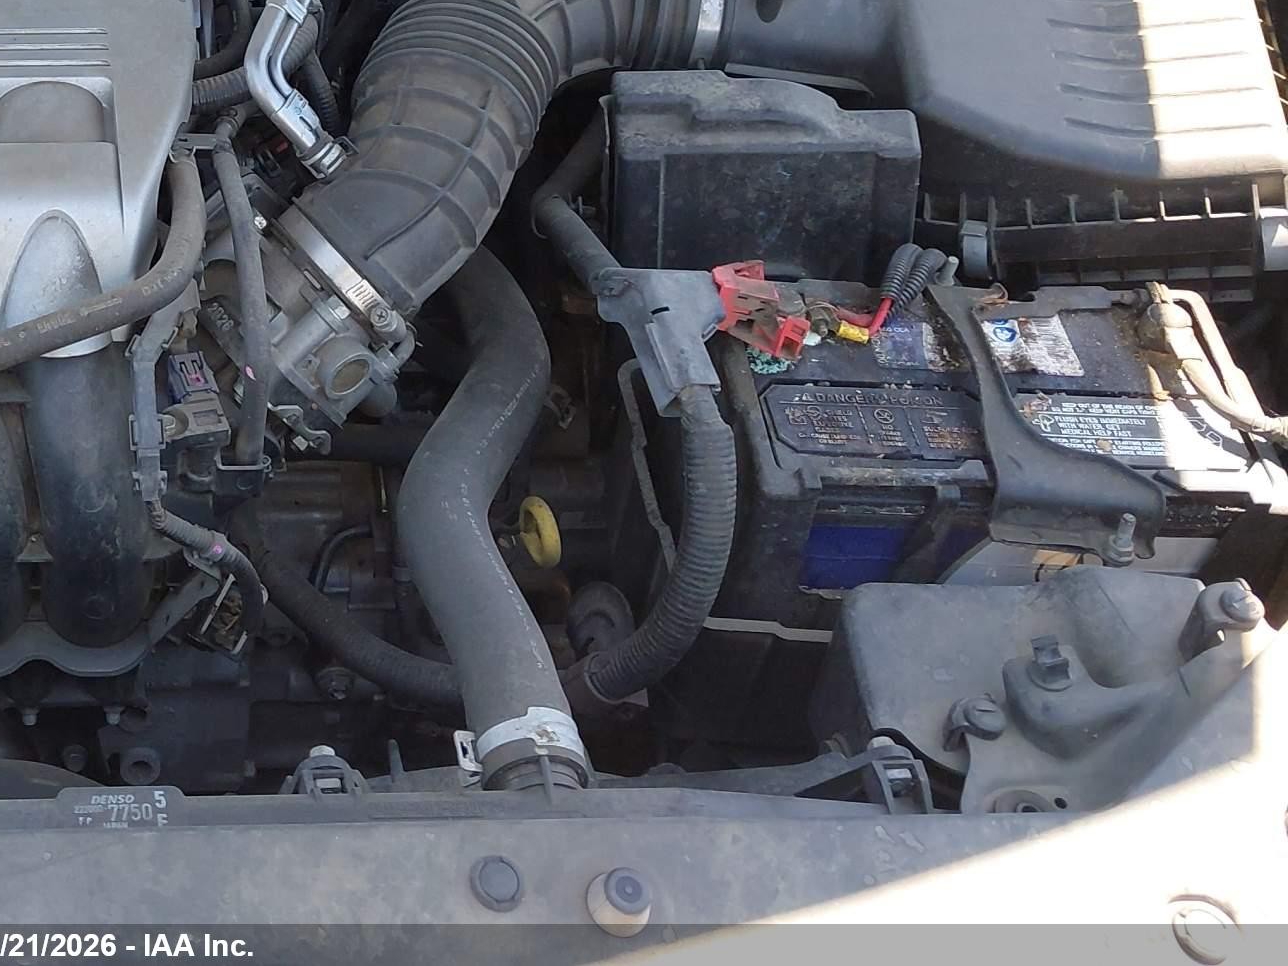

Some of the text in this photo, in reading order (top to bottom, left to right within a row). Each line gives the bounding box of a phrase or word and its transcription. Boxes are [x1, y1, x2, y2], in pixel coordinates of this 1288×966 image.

[1054, 415, 1078, 424] FLUSH
[1080, 416, 1099, 425] EYES
[1092, 429, 1113, 437] HELP
[90, 790, 168, 809] DENSO 5
